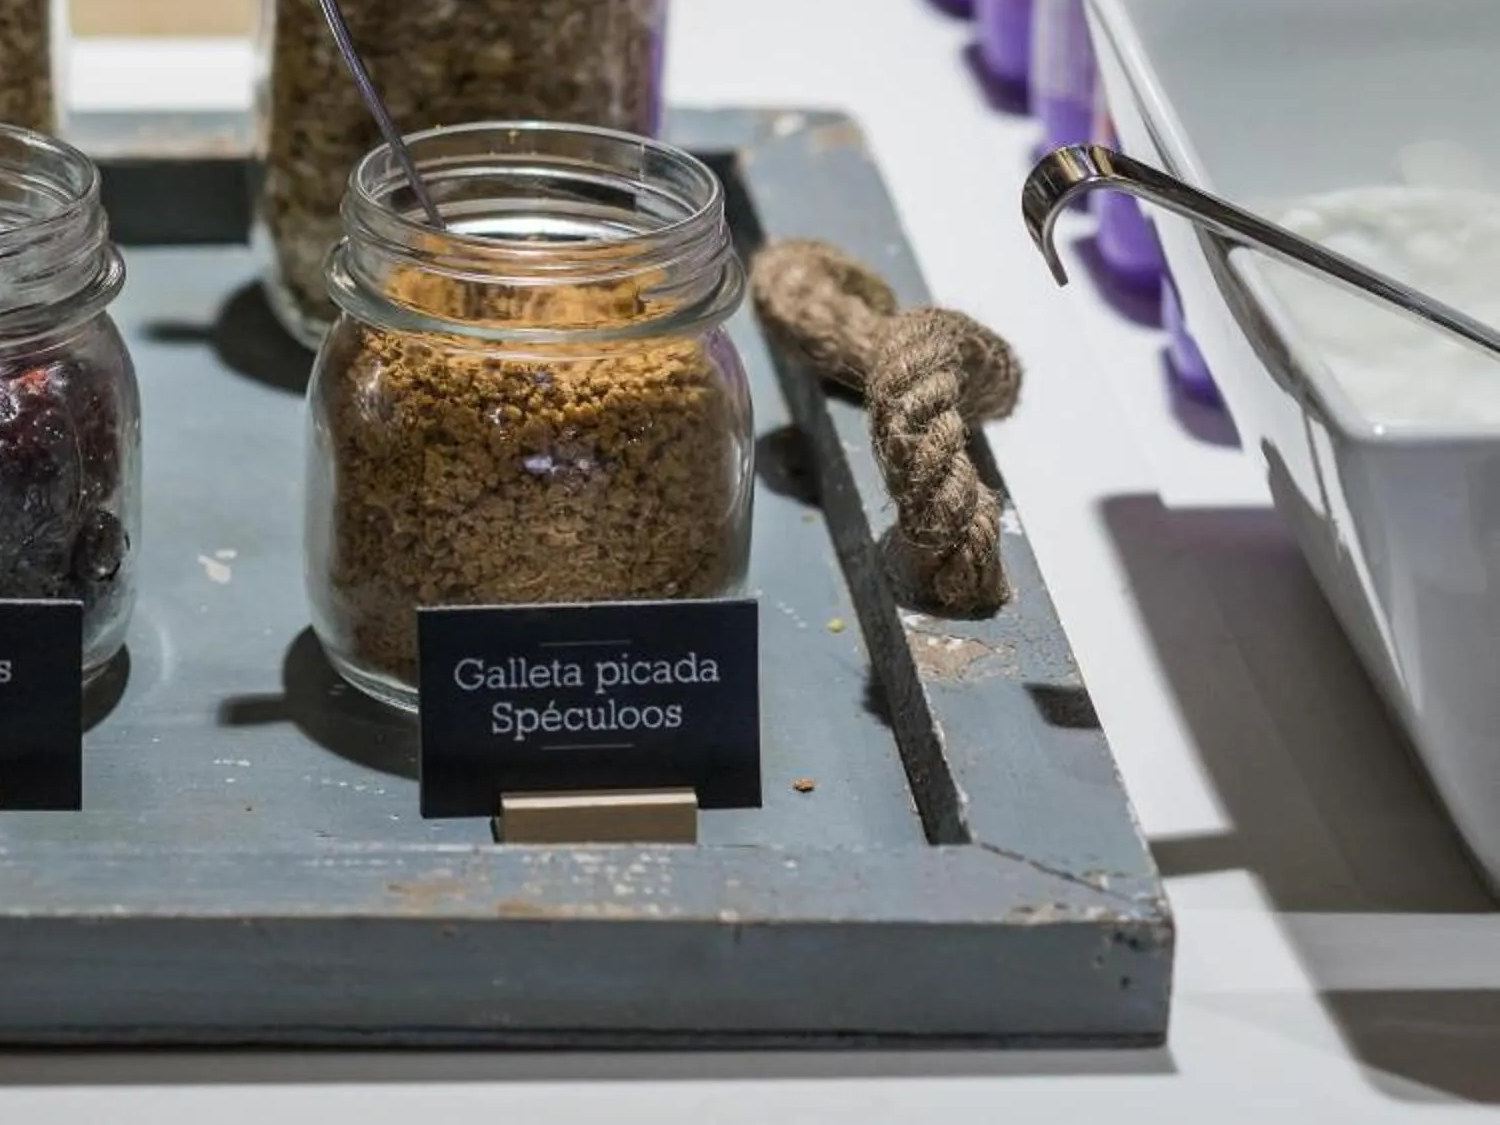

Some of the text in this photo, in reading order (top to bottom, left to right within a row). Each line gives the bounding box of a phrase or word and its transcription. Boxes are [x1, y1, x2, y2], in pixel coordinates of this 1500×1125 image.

[453, 651, 721, 695] Galleta picada
[491, 698, 683, 742] Spéculoos
